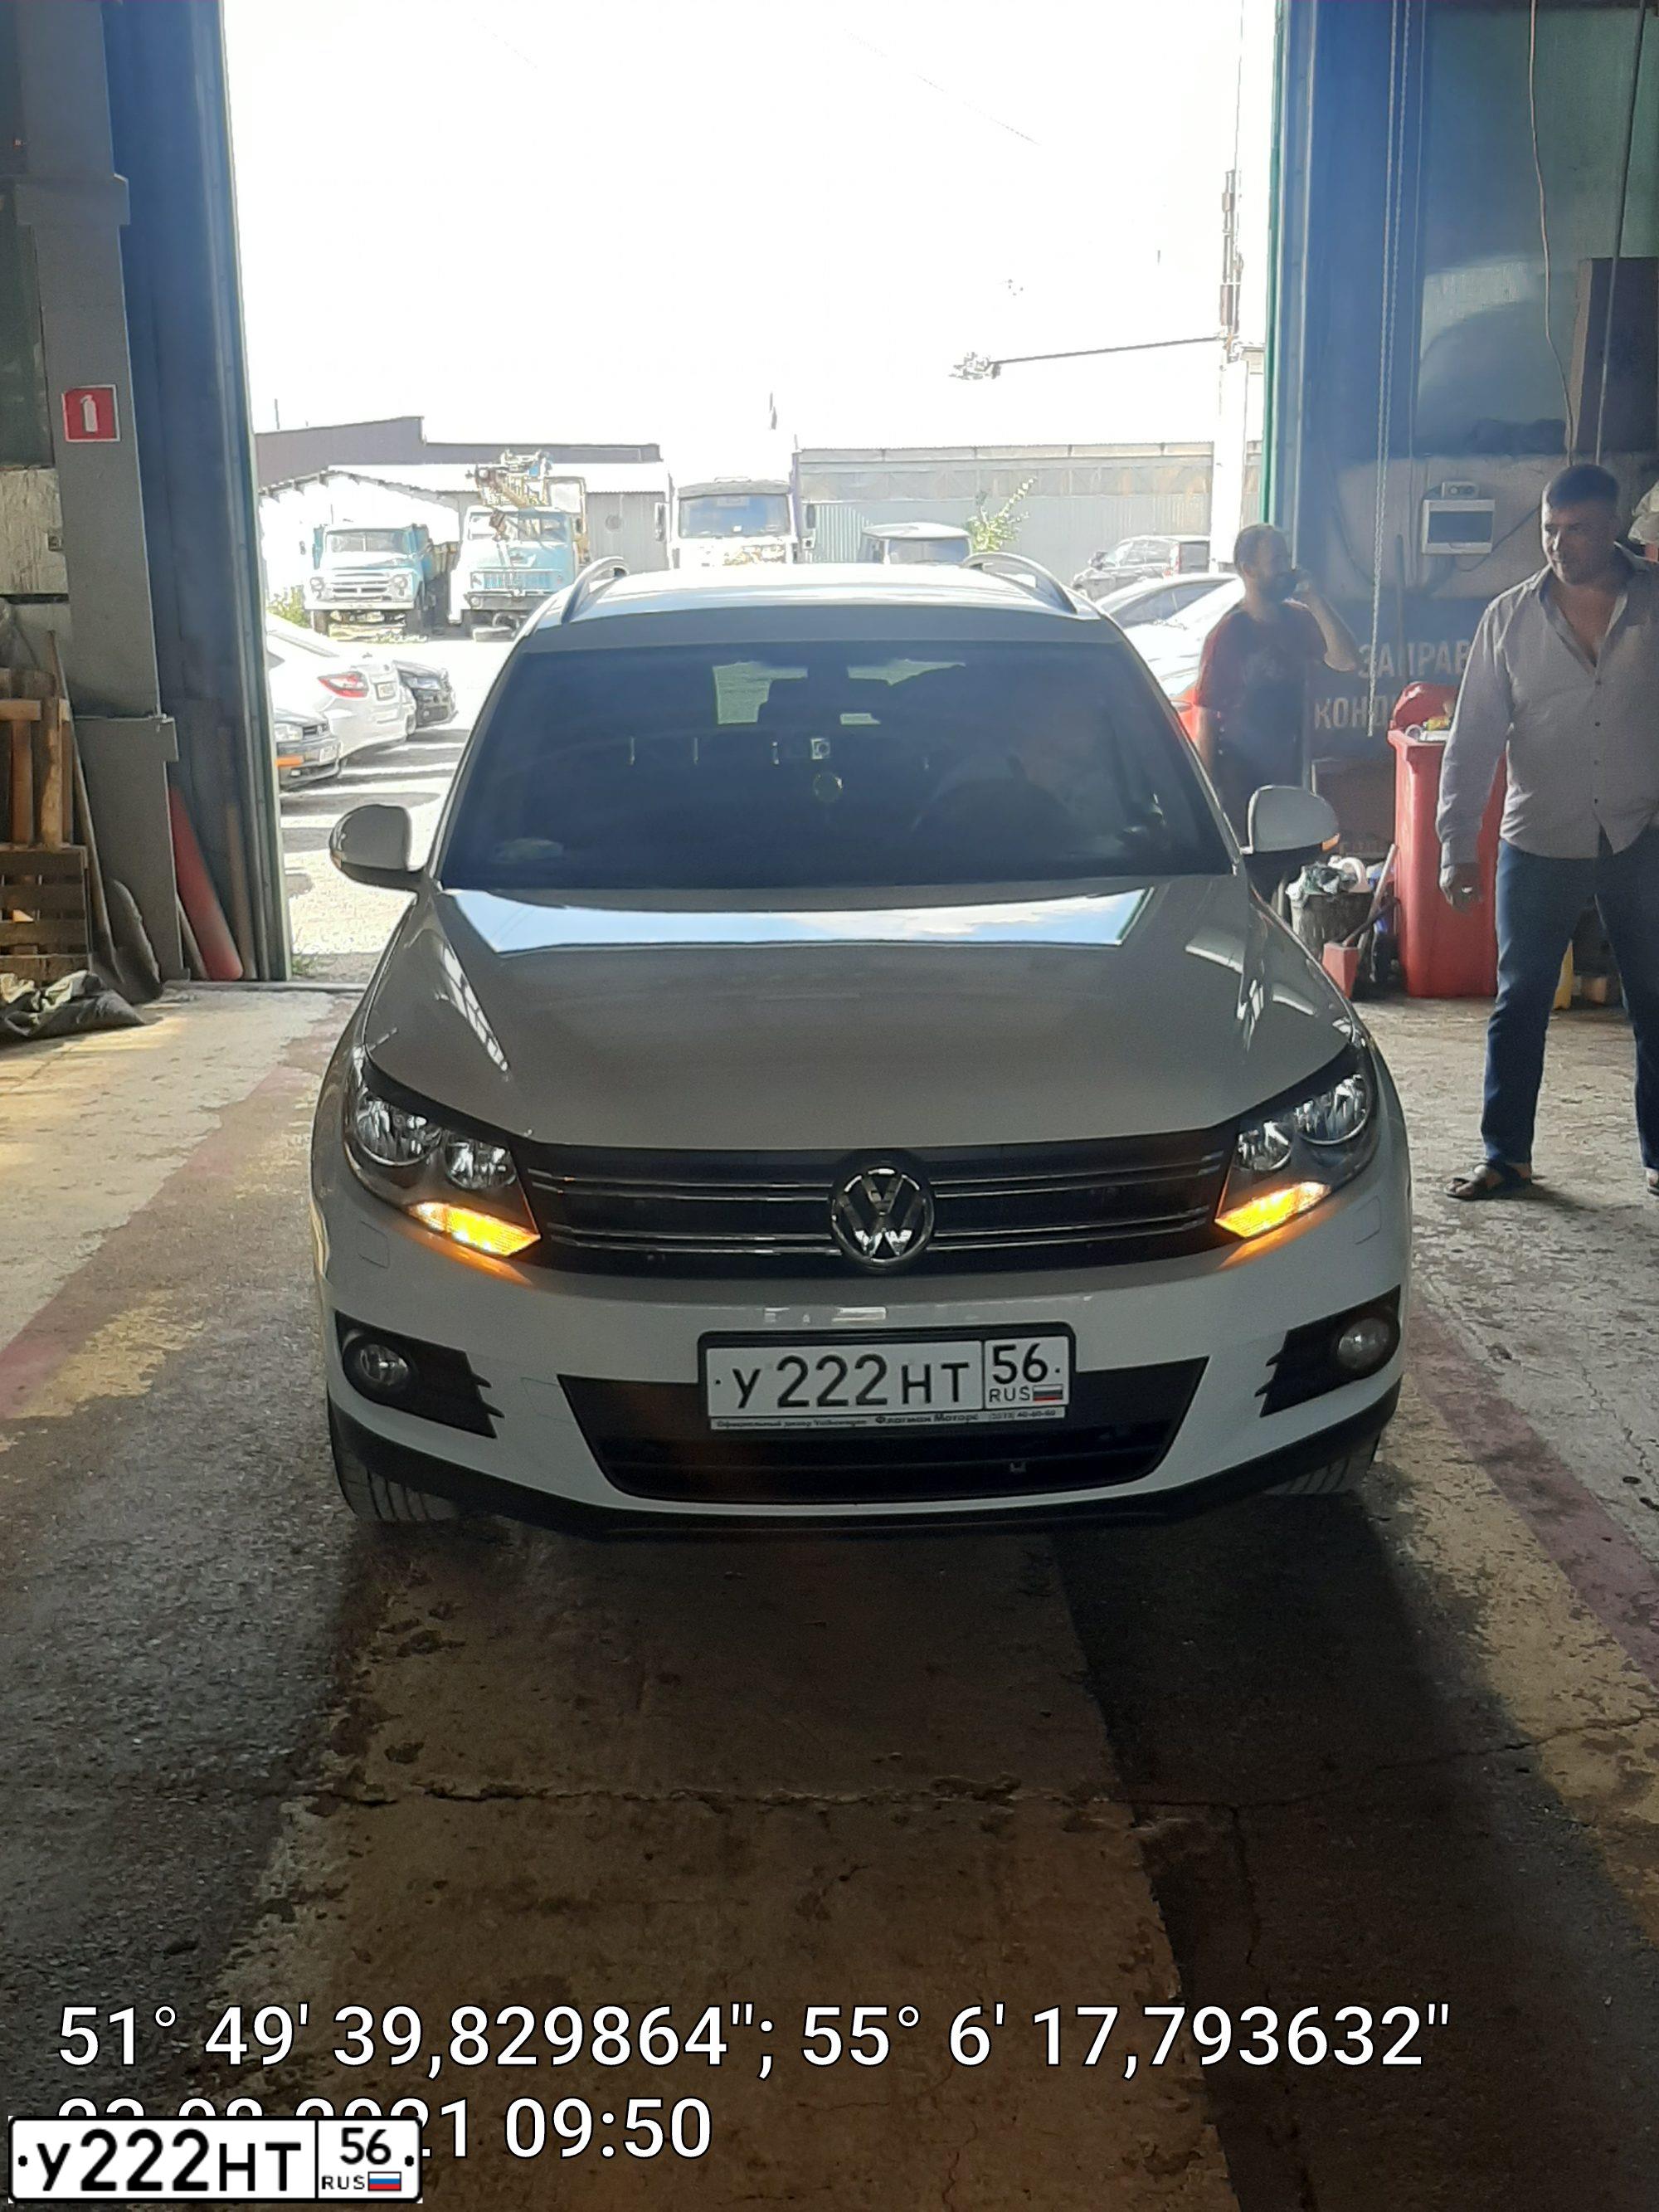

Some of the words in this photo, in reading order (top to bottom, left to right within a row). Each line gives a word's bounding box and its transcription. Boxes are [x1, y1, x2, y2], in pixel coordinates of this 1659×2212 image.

[1311, 694, 1397, 730] КОНД
[992, 1342, 1048, 1385] 56
[989, 1386, 1030, 1402] RUS
